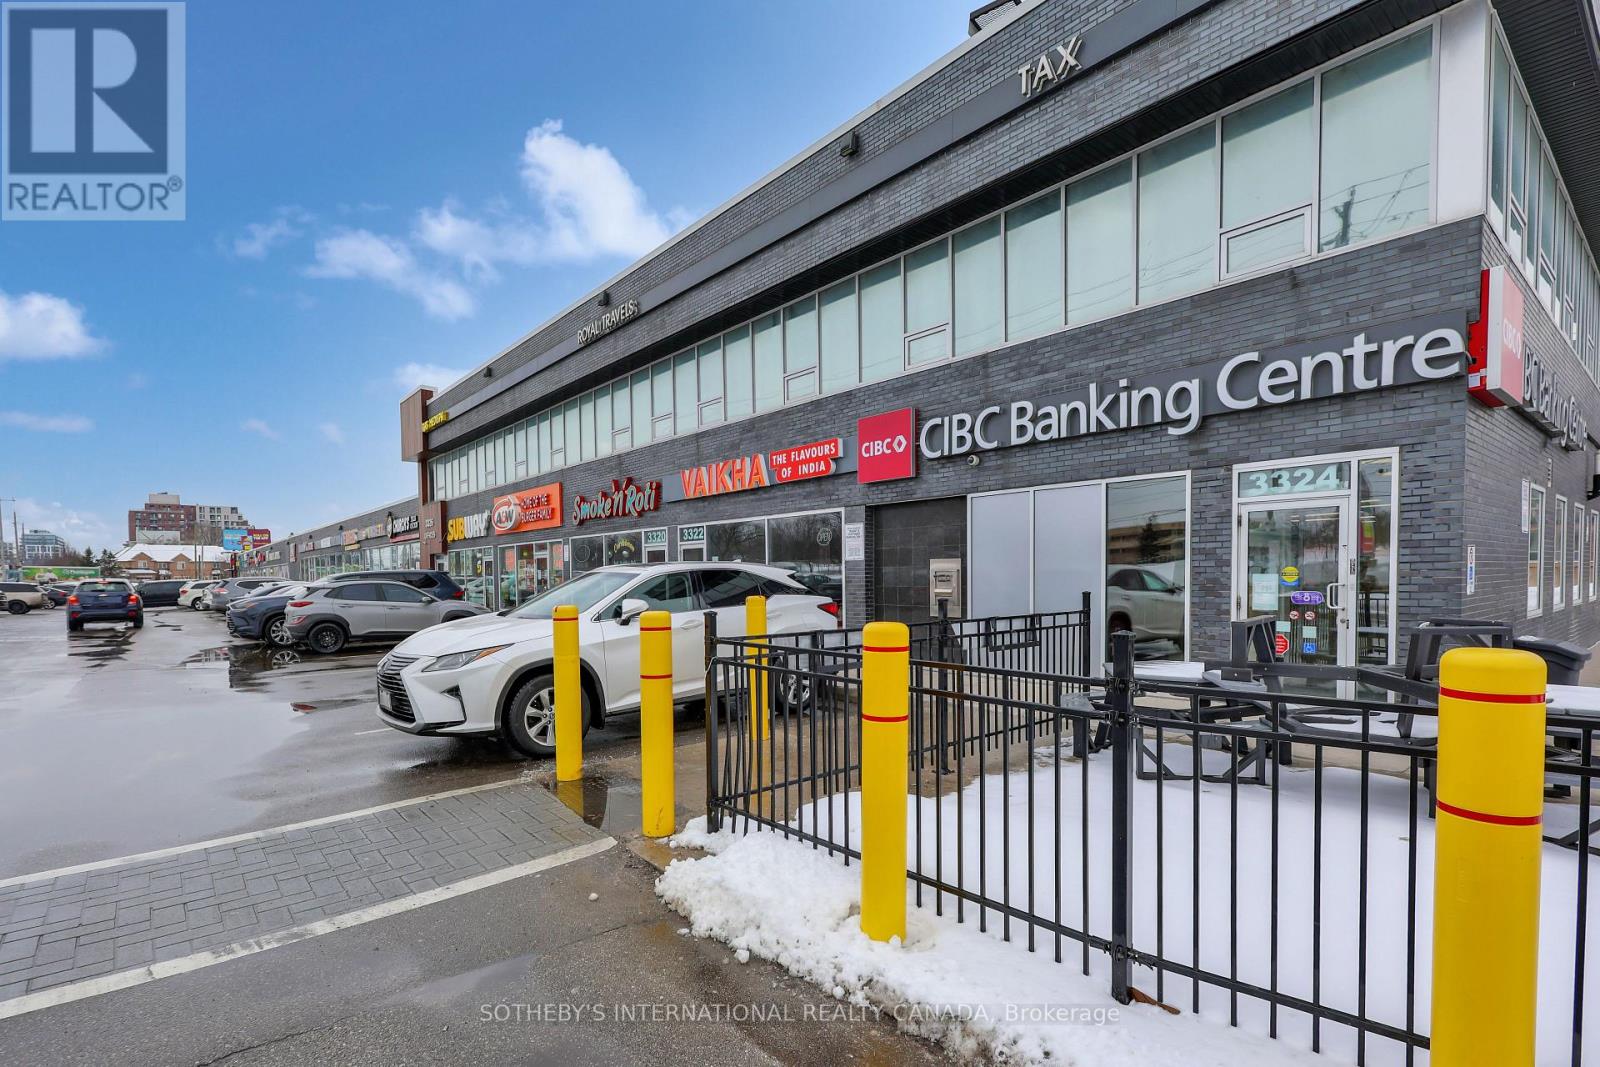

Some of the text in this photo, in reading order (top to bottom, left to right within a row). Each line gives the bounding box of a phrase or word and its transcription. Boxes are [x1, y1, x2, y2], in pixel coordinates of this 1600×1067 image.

[1018, 33, 1081, 96] TAX
[577, 299, 637, 345] ROYAL TRAVELS
[919, 328, 1466, 459] CIBC Banking Centre
[772, 442, 836, 466] THE FLAVOURS
[861, 438, 892, 458] CIBC
[680, 453, 768, 500] VAIKHA
[781, 460, 826, 479] OF INDIA
[1247, 464, 1341, 497] 3324
[625, 481, 657, 517] Roti
[447, 509, 489, 544] SUBWAY
[496, 507, 514, 525] A&W
[647, 531, 666, 543] 3320
[683, 527, 704, 541] 3322
